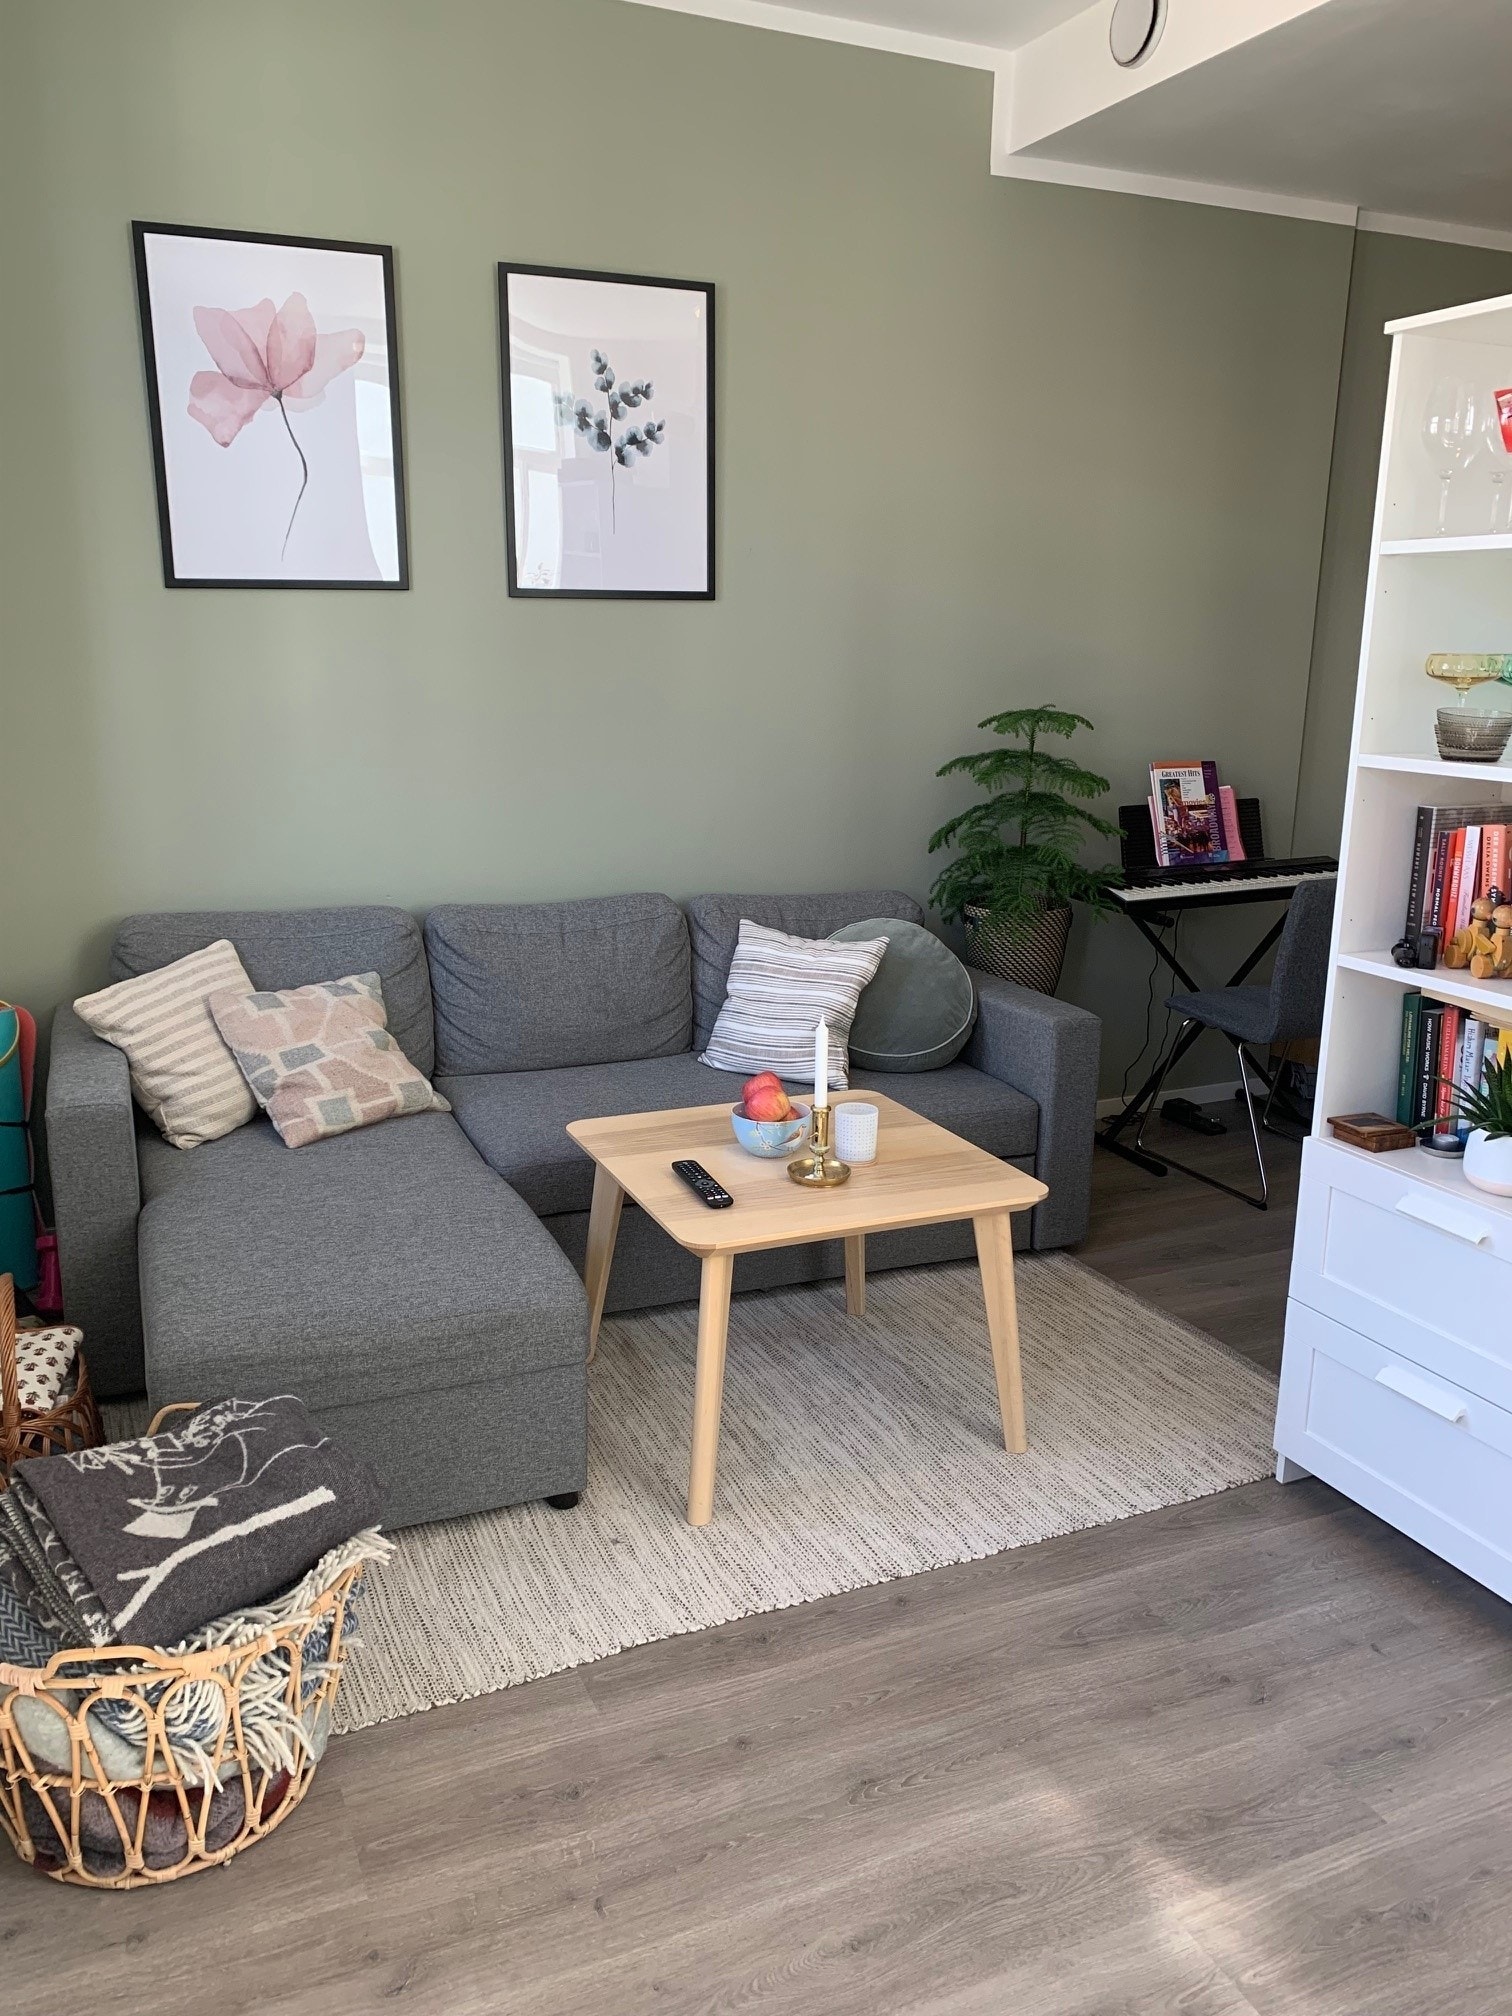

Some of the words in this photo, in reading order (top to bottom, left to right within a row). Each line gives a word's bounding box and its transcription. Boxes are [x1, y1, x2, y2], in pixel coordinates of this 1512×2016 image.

[1208, 804, 1221, 851] BROADWAY
[1450, 857, 1461, 898] SOMMERQUIZ
[1433, 887, 1441, 913] NORMAL
